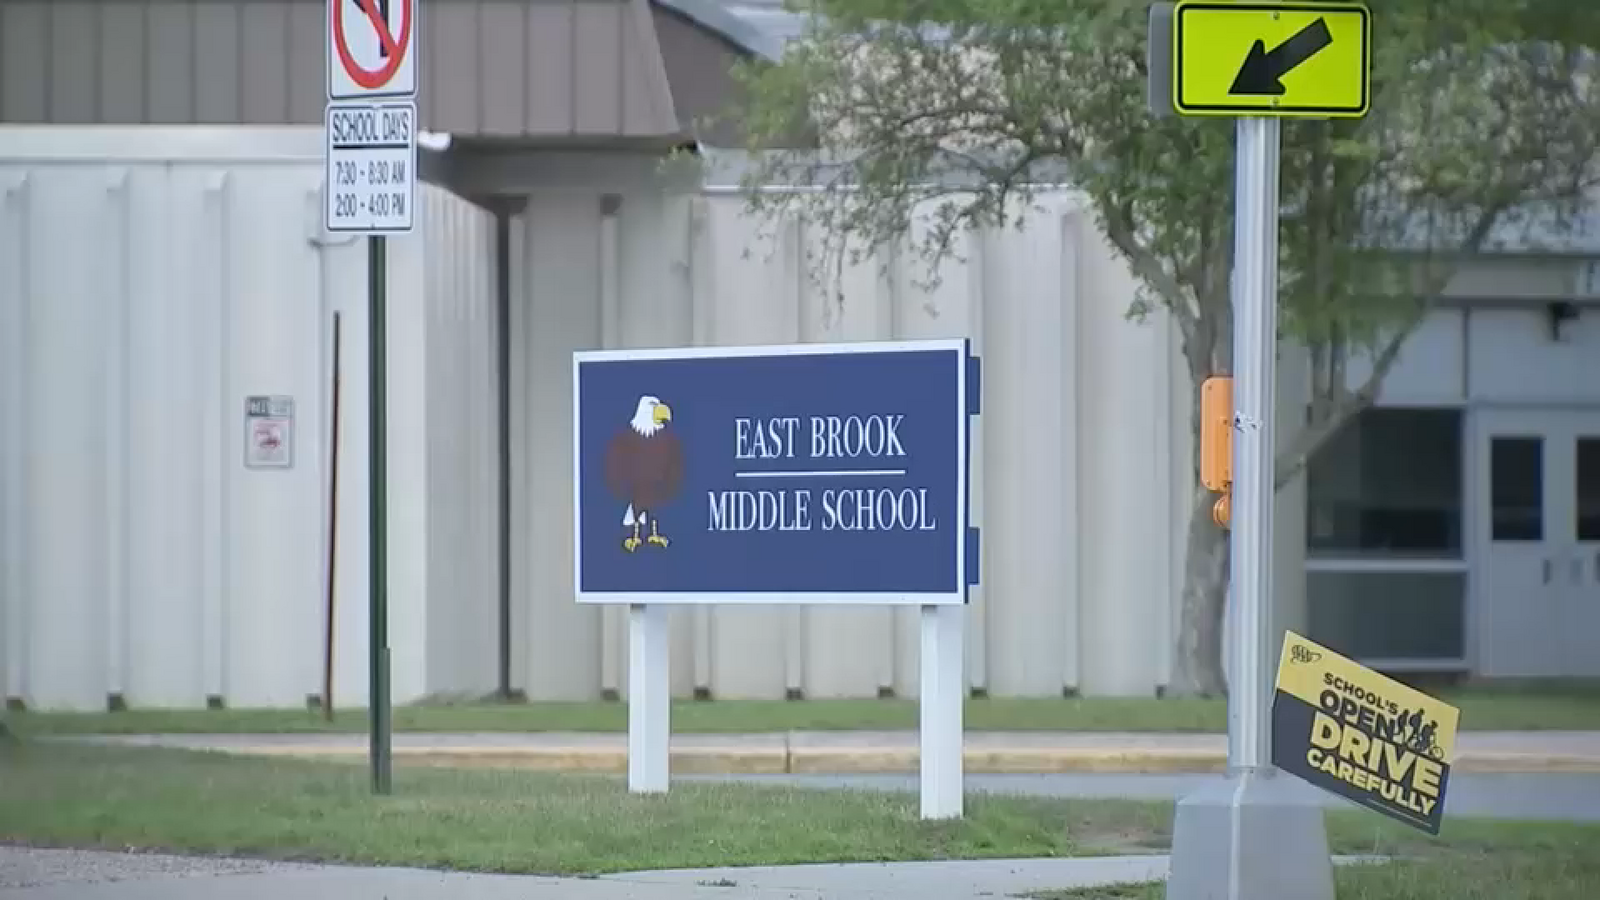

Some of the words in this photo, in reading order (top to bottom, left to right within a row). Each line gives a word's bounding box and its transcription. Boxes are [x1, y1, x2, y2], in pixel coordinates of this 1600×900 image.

[333, 113, 379, 142] SCHOOL
[383, 112, 409, 141] DAYS
[335, 161, 357, 184] 7:30
[368, 160, 388, 184] 8:30
[392, 160, 406, 184] AM
[335, 194, 357, 217] 2:00
[368, 193, 388, 216] 4:00
[392, 192, 405, 216] PM
[735, 417, 801, 459] EAST
[810, 414, 906, 458] BROOK
[707, 490, 811, 531] MIDDLE
[821, 488, 936, 531] SCHOOL
[1323, 672, 1399, 715] SCHOOL'S
[1319, 689, 1397, 742] OPEN
[1311, 710, 1443, 798] DRIVE
[1306, 748, 1438, 817] CAREFULLY
